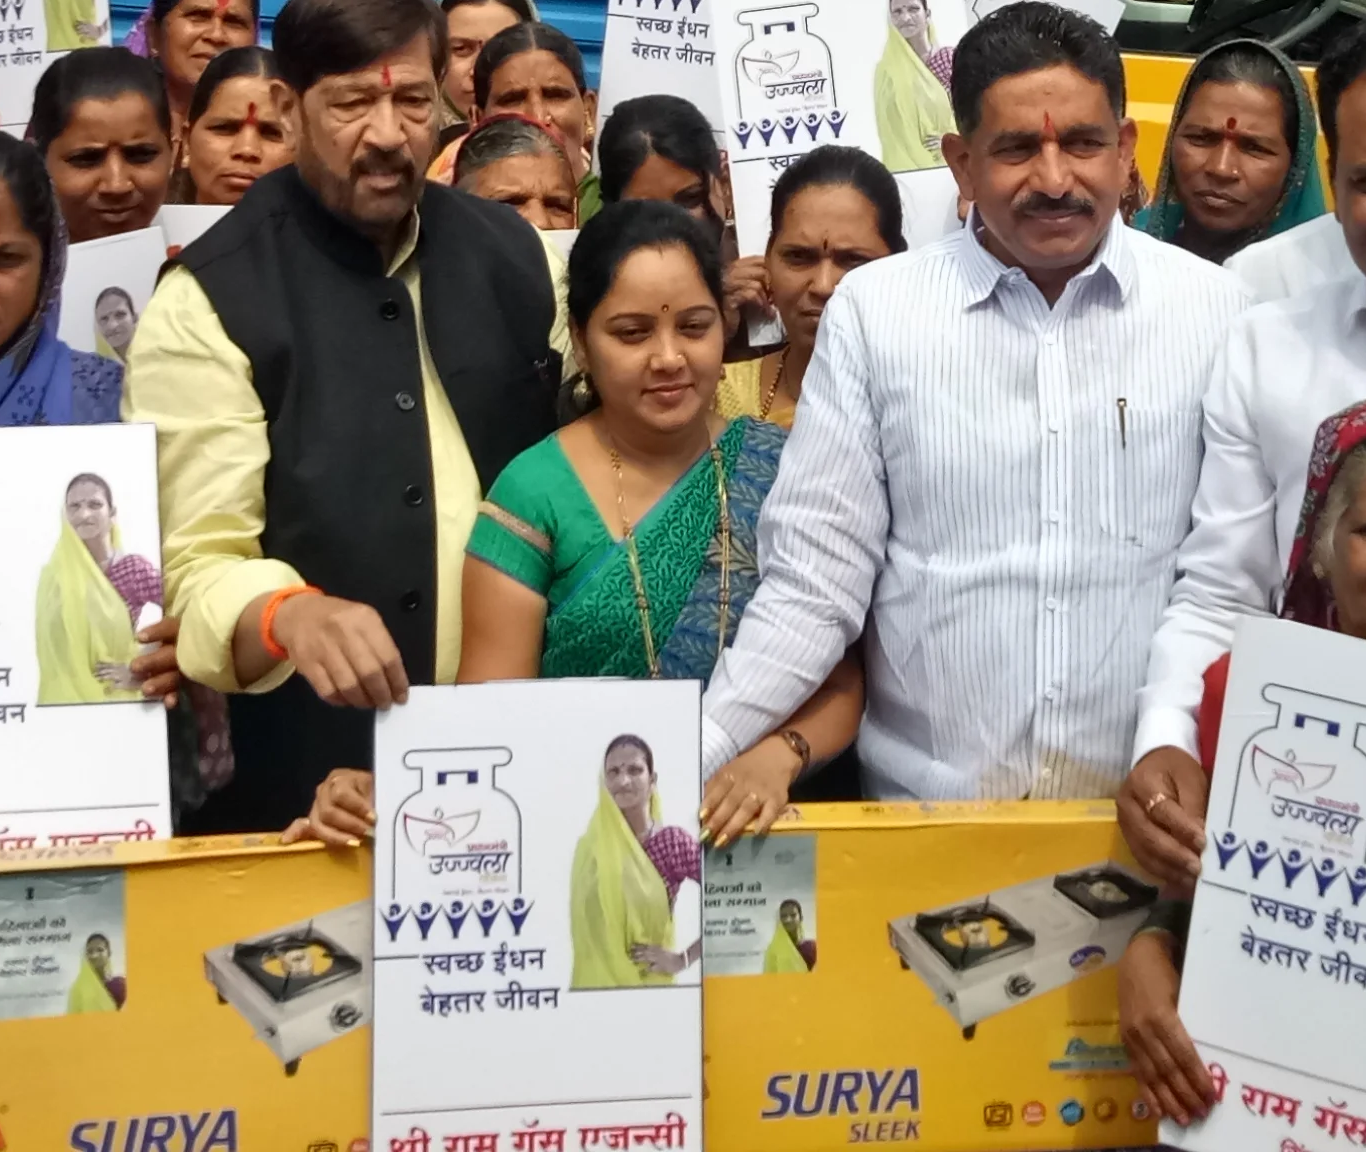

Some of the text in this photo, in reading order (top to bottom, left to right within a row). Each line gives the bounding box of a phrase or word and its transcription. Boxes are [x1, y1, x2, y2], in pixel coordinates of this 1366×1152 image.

[636, 16, 673, 34] स्वच्छ
[10, 47, 42, 65] जीवन
[631, 36, 716, 66] बेहतर जीवन
[1250, 893, 1317, 930] स्वच्छ
[422, 951, 485, 975] स्वच्छ
[1241, 924, 1312, 972] बेहतर
[419, 980, 560, 1018] बेहतर जीवन
[761, 1068, 920, 1120] SURYA
[1241, 1083, 1302, 1127] राम
[70, 1109, 238, 1152] SURYA
[579, 1111, 687, 1151] एजन्सी
[846, 1119, 922, 1144] SLEEK
